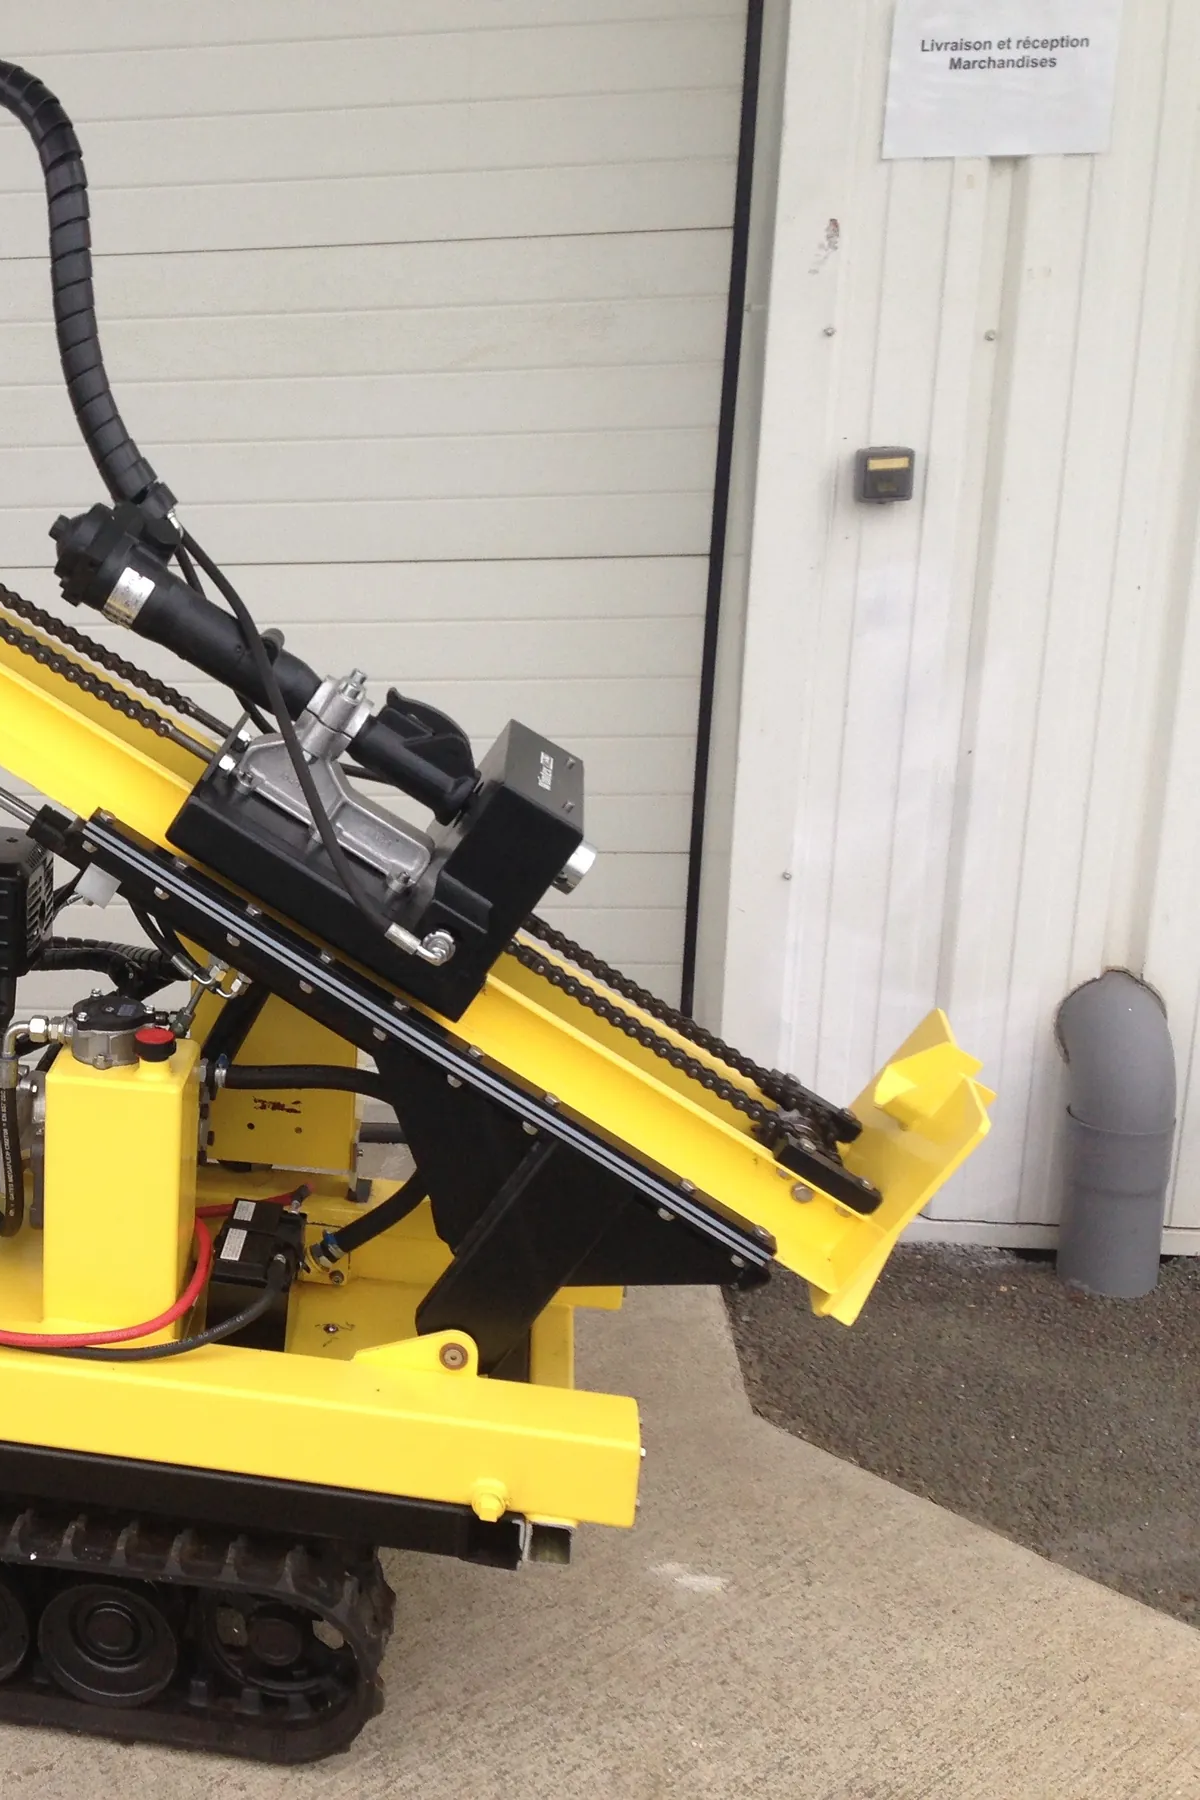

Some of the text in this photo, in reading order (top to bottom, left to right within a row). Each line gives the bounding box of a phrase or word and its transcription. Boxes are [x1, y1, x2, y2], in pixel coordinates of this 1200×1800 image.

[920, 35, 1090, 52] Livraison et réception
[949, 56, 1057, 70] Marchandises
